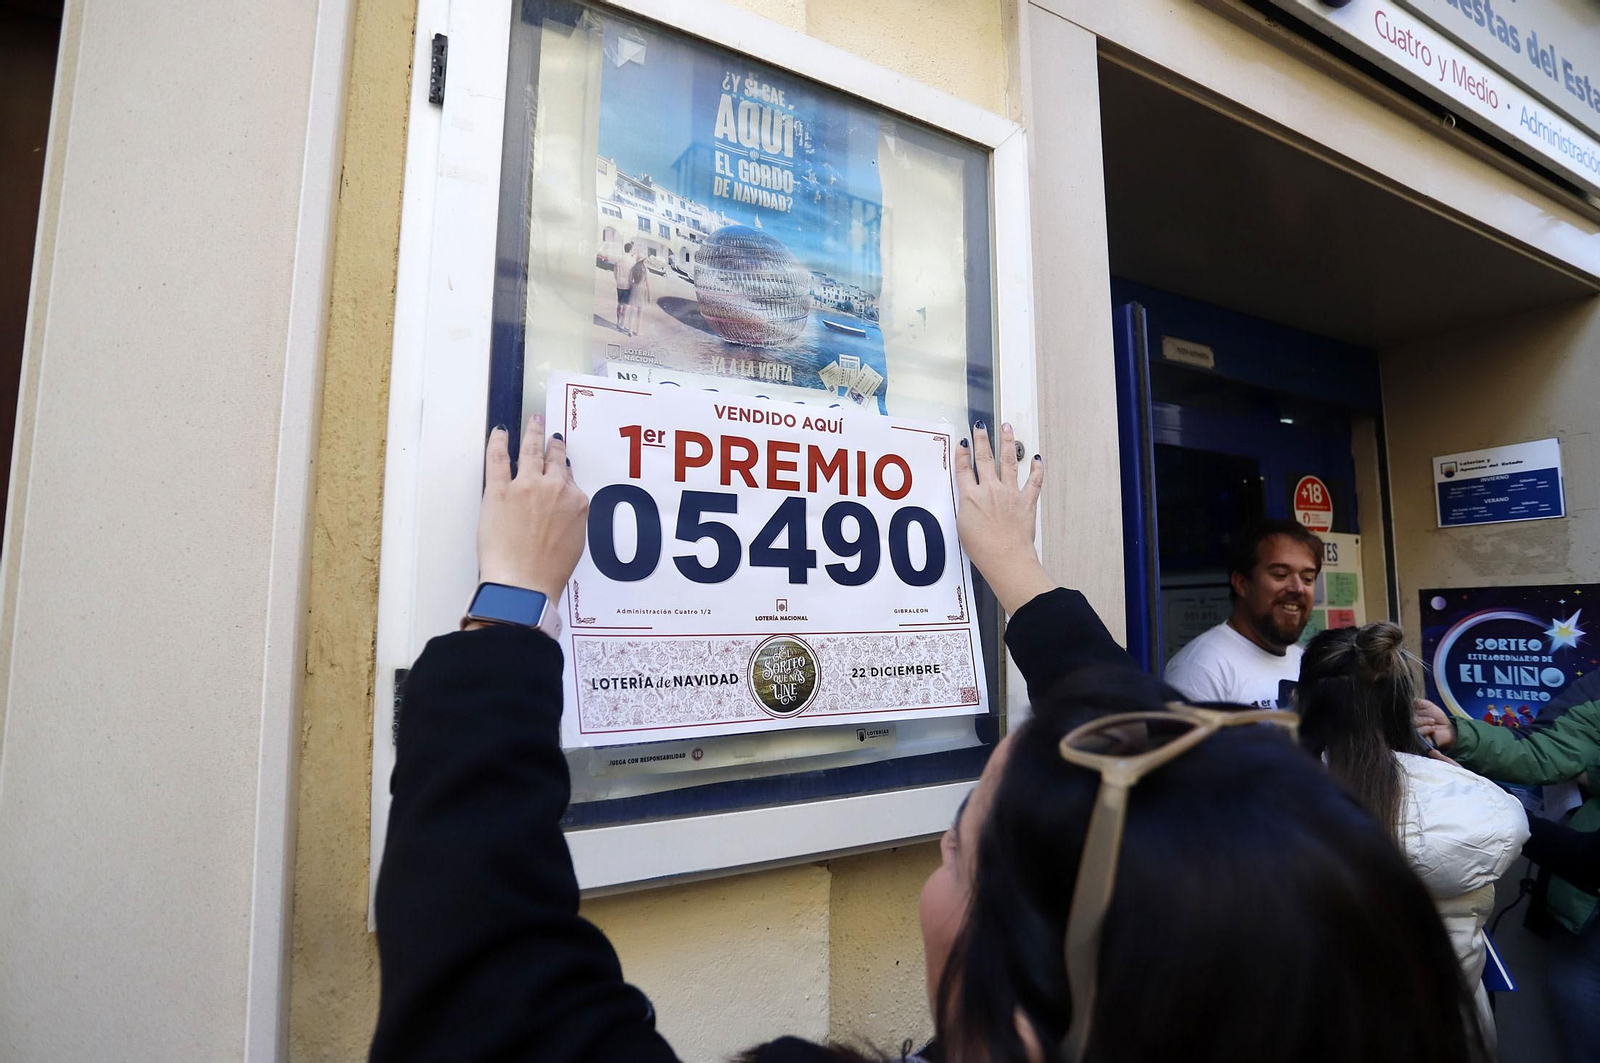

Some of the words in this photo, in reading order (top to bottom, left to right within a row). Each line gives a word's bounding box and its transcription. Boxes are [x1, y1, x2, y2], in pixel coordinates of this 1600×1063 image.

[1374, 10, 1432, 67] Cuatro
[1437, 54, 1447, 82] y
[1451, 58, 1499, 109] Medio
[1526, 30, 1559, 82] del
[722, 71, 741, 93] ¿Y
[715, 150, 734, 178] EL
[738, 158, 794, 194] GORDO
[713, 176, 731, 198] DE
[733, 181, 793, 213] NAVIDAD?
[624, 355, 662, 365] NACIONAL
[711, 355, 726, 374] YA
[729, 358, 738, 375] A
[758, 361, 793, 383] VENTA
[714, 404, 796, 428] VENDIDO
[802, 416, 843, 434] AQUÍ
[619, 424, 666, 479] 1er
[674, 429, 913, 501] PREMIO
[1480, 474, 1510, 482] INVIERNO
[1301, 483, 1323, 504] +18
[1484, 496, 1510, 504] VERANO
[587, 483, 947, 587] 05490
[616, 607, 672, 615] Administración
[1475, 638, 1543, 651] SORTEO
[1468, 653, 1539, 662] EXTRAORDINARIO
[762, 656, 805, 681] SORTEO
[773, 674, 788, 684] QUE
[789, 669, 805, 684] NOS
[851, 667, 866, 679] 22
[870, 664, 941, 677] DICIEMBRE
[1459, 664, 1487, 684] EL
[1494, 665, 1565, 688] NIÑO
[592, 674, 654, 691] LOTERÍA
[656, 677, 671, 689] de
[673, 673, 739, 688] NAVIDAD
[769, 683, 797, 705] UNE
[1476, 687, 1484, 697] 6
[1487, 689, 1503, 699] DE
[1506, 690, 1551, 702] ENERO
[627, 757, 639, 765] CON
[640, 752, 686, 763] RESPONSABILIDAD
